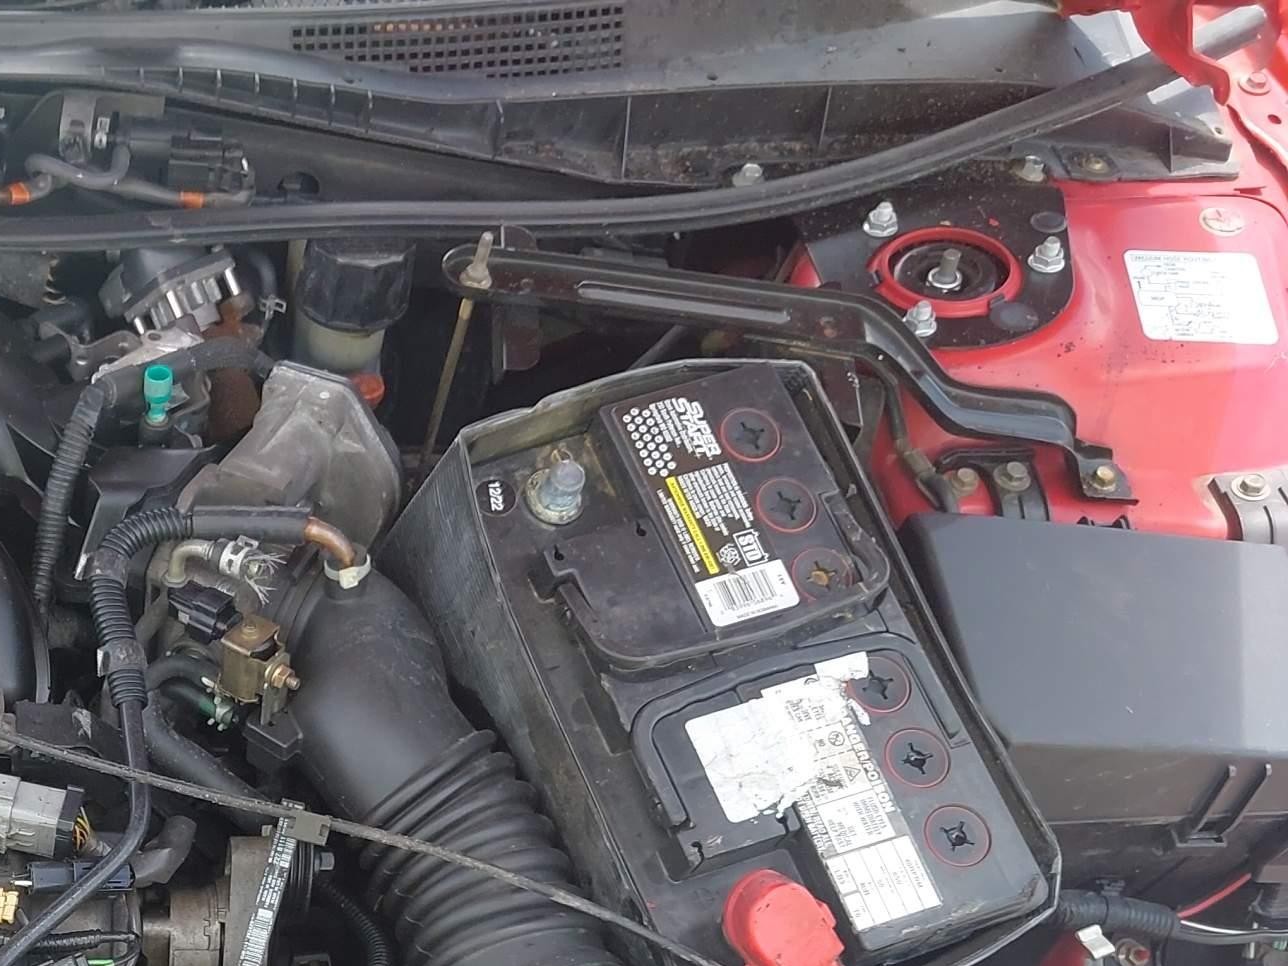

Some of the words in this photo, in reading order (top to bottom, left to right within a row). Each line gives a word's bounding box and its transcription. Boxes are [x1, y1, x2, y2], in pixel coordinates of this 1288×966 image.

[673, 396, 707, 456] START
[687, 400, 722, 456] SUPER
[487, 481, 504, 511] 12/22
[737, 534, 760, 561] STD
